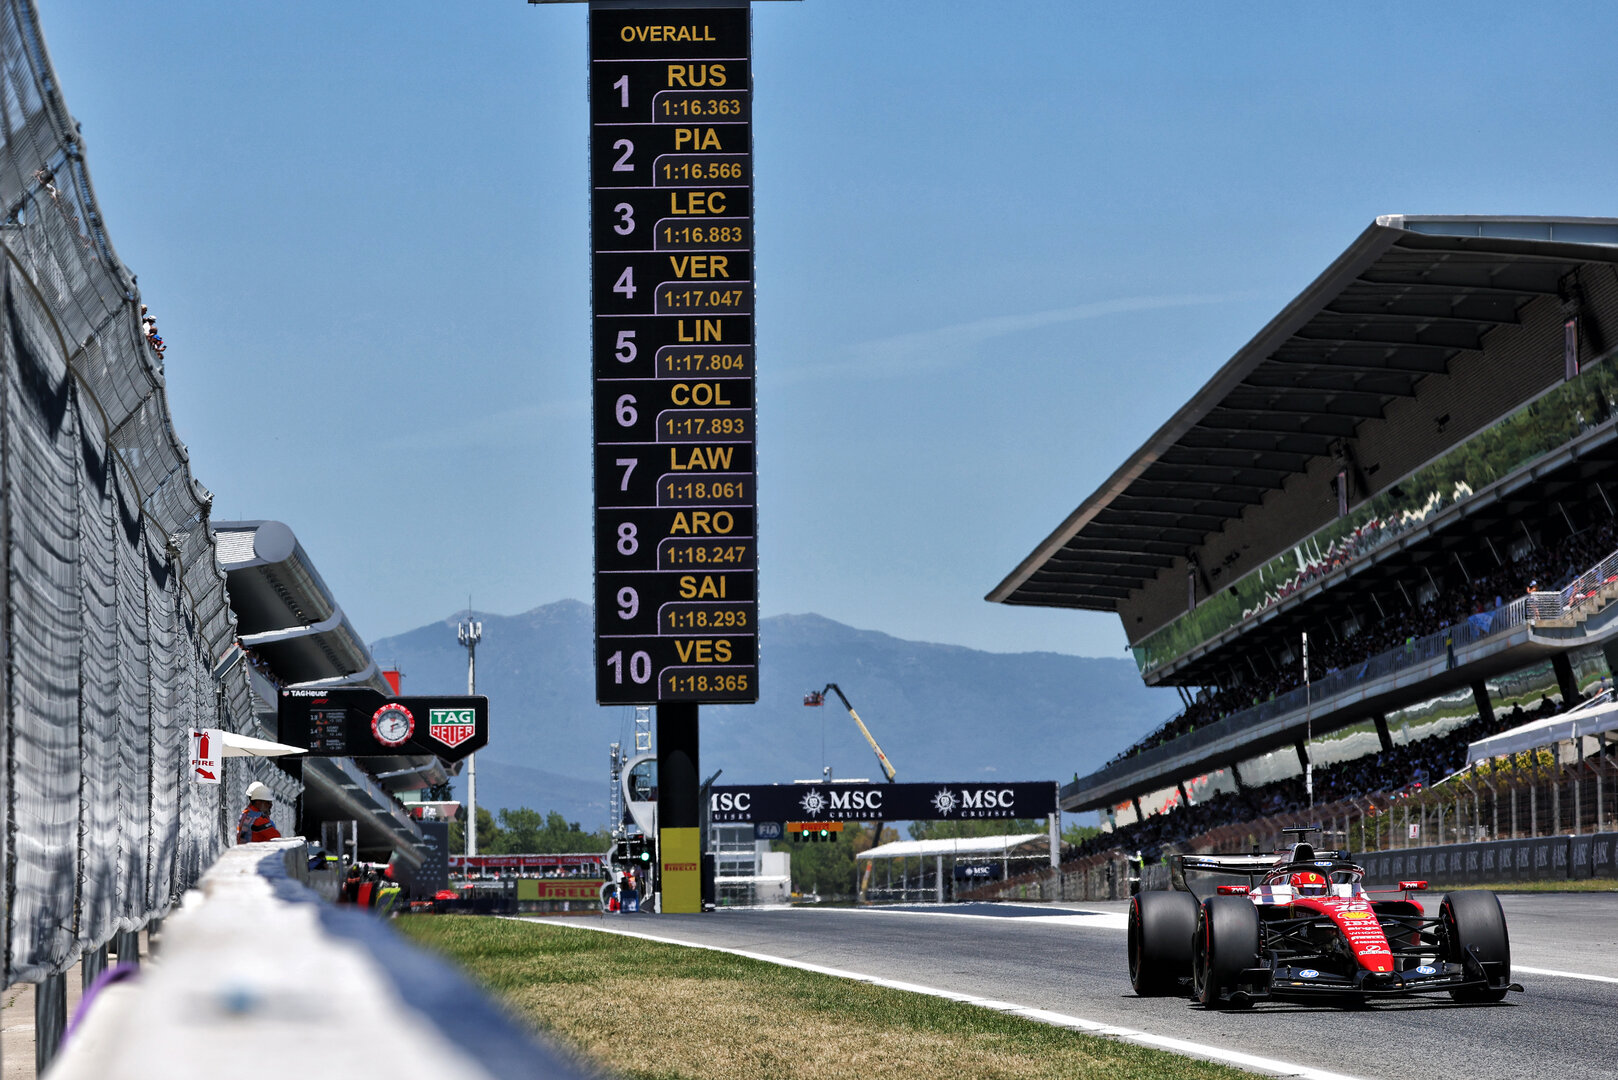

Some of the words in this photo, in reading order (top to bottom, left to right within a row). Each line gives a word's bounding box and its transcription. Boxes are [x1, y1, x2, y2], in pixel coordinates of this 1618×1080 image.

[620, 25, 716, 42] OVERALL
[668, 64, 726, 86] RUS
[613, 75, 629, 108] 1
[663, 100, 740, 115] 1:16.363
[676, 128, 721, 150] PIA
[612, 139, 635, 171] 2
[664, 163, 741, 179] 1:16.566
[672, 192, 726, 214] LEC
[613, 203, 635, 235] 3
[664, 227, 741, 242] 1:16.883
[670, 256, 728, 277] VER
[613, 266, 637, 299] 4
[665, 291, 742, 306] 1:17.047
[679, 320, 721, 341] LIN
[615, 331, 637, 363] 5
[666, 355, 743, 370] 1:17.804
[672, 383, 730, 405] COL
[615, 394, 638, 427] 6
[667, 419, 744, 434] 1:17.893
[671, 448, 733, 469] LAW
[616, 458, 638, 491] 7
[667, 483, 743, 498] 1:18.061
[670, 511, 733, 533] ARO
[617, 522, 639, 555] 8
[668, 547, 745, 563] 1:18.247
[680, 576, 725, 598] SAI
[617, 587, 639, 620] 9
[669, 611, 746, 627] 1:18.293
[675, 640, 731, 662] VES
[607, 651, 651, 684] 10
[669, 675, 747, 691] 1:18.365
[433, 712, 471, 723] TAG
[432, 726, 472, 744] HEUER
[829, 791, 882, 809] MSC
[962, 790, 1014, 808] MSC
[759, 825, 778, 834] FIA
[664, 863, 697, 871] PIRELLI
[538, 881, 604, 897] PIRELL
[1302, 970, 1317, 978] hp
[1418, 966, 1434, 974] hp
